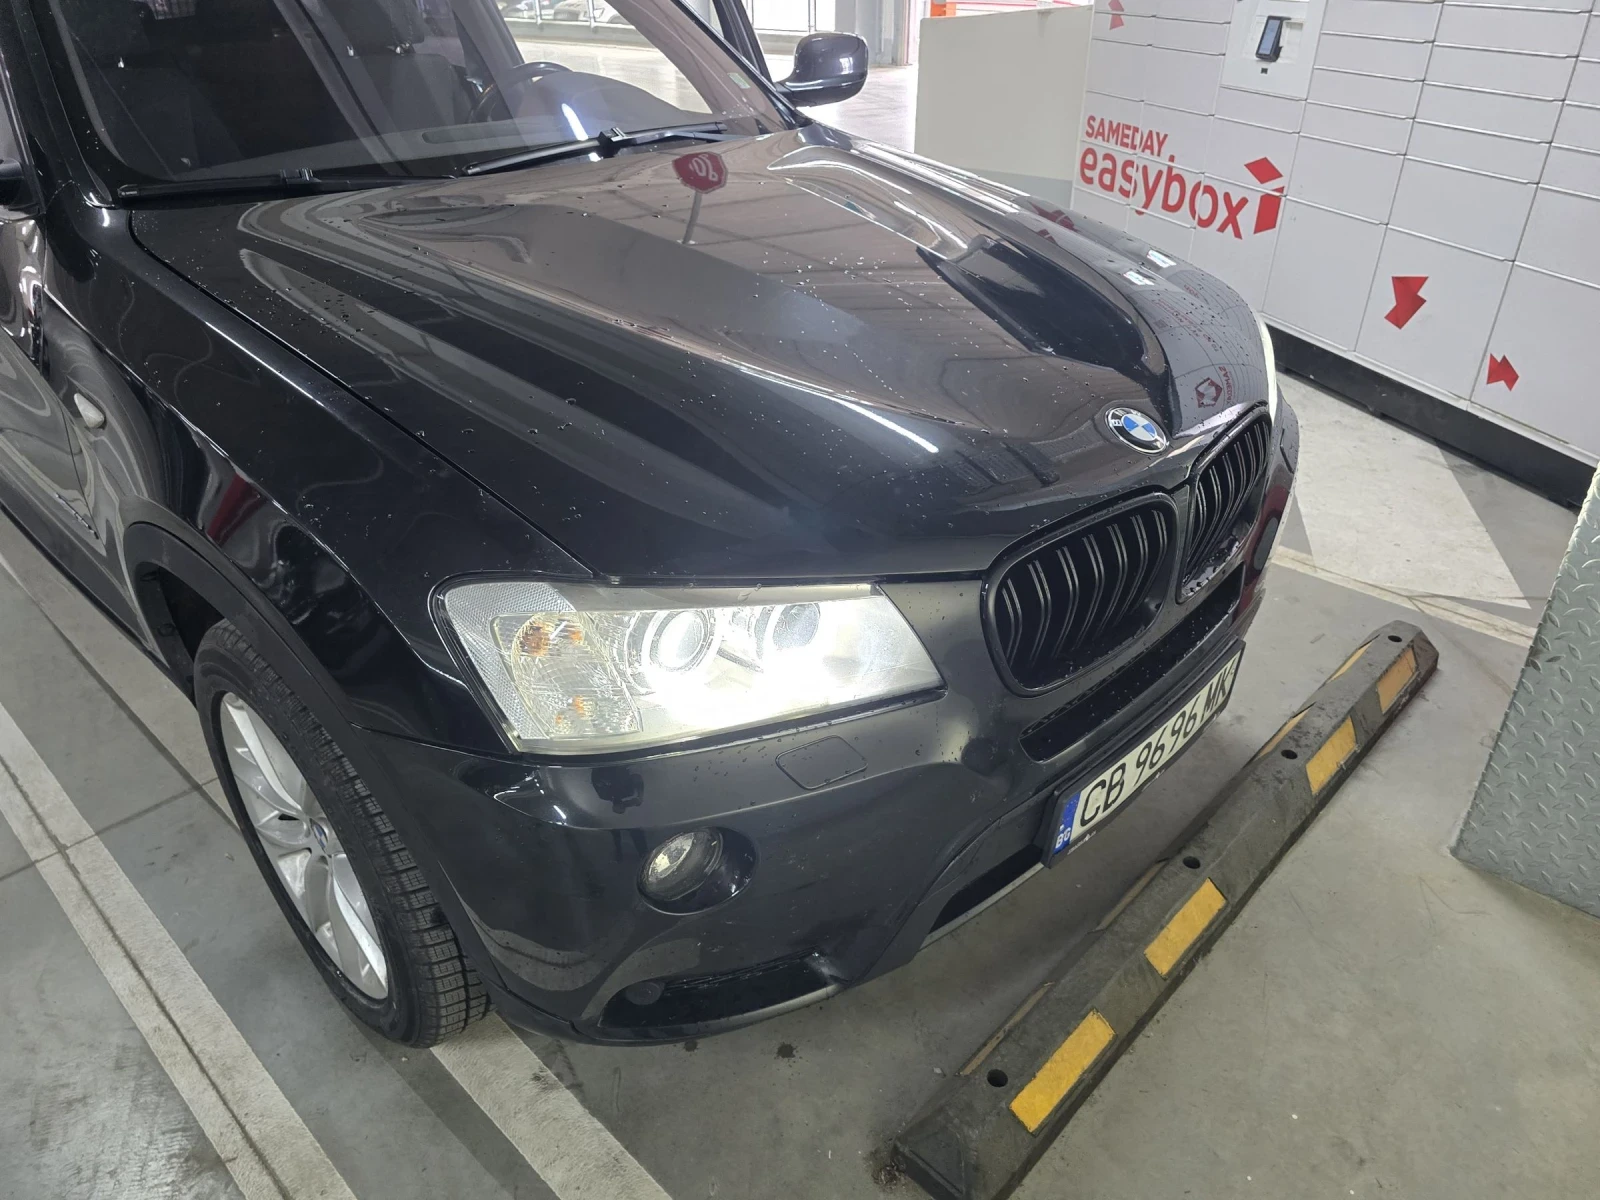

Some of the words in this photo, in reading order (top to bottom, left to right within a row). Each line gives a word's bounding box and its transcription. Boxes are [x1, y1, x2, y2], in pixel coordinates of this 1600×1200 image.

[1085, 115, 1168, 157] SAMEDAY
[1079, 147, 1249, 240] easybox
[1055, 826, 1072, 850] BG
